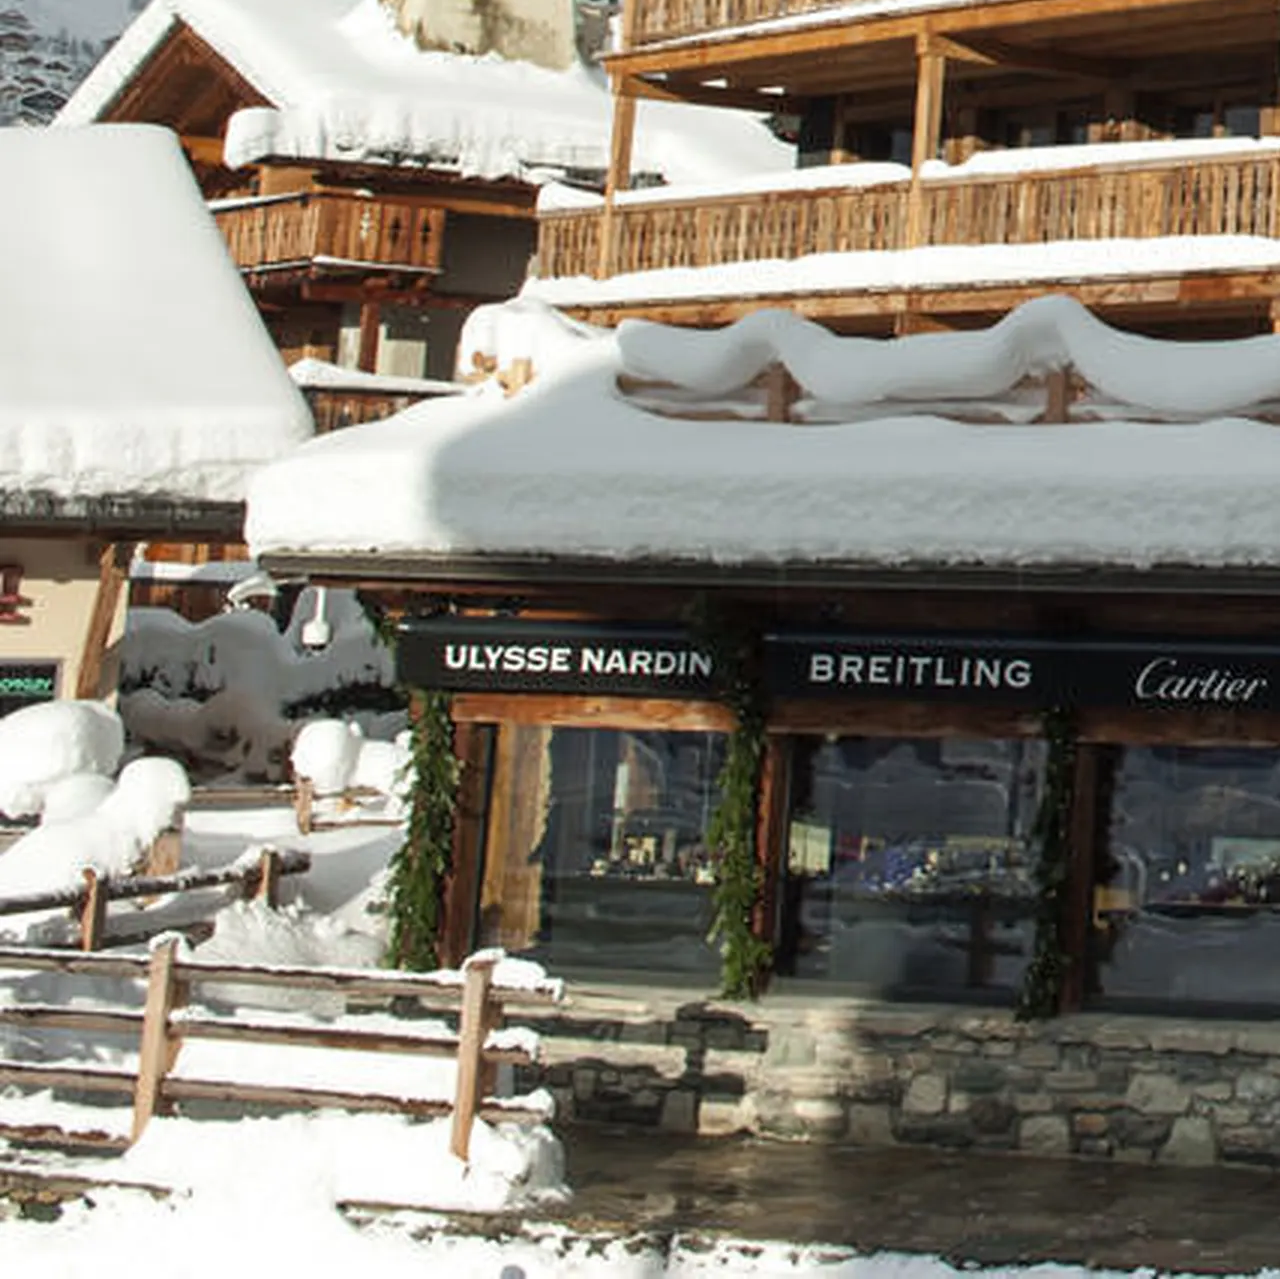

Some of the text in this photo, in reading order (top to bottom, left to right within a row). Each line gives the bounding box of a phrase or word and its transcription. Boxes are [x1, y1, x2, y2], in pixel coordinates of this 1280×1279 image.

[445, 644, 713, 677] ULYSSE NARDIN
[809, 653, 1032, 689] BREITLING
[1135, 657, 1267, 700] Cartier
